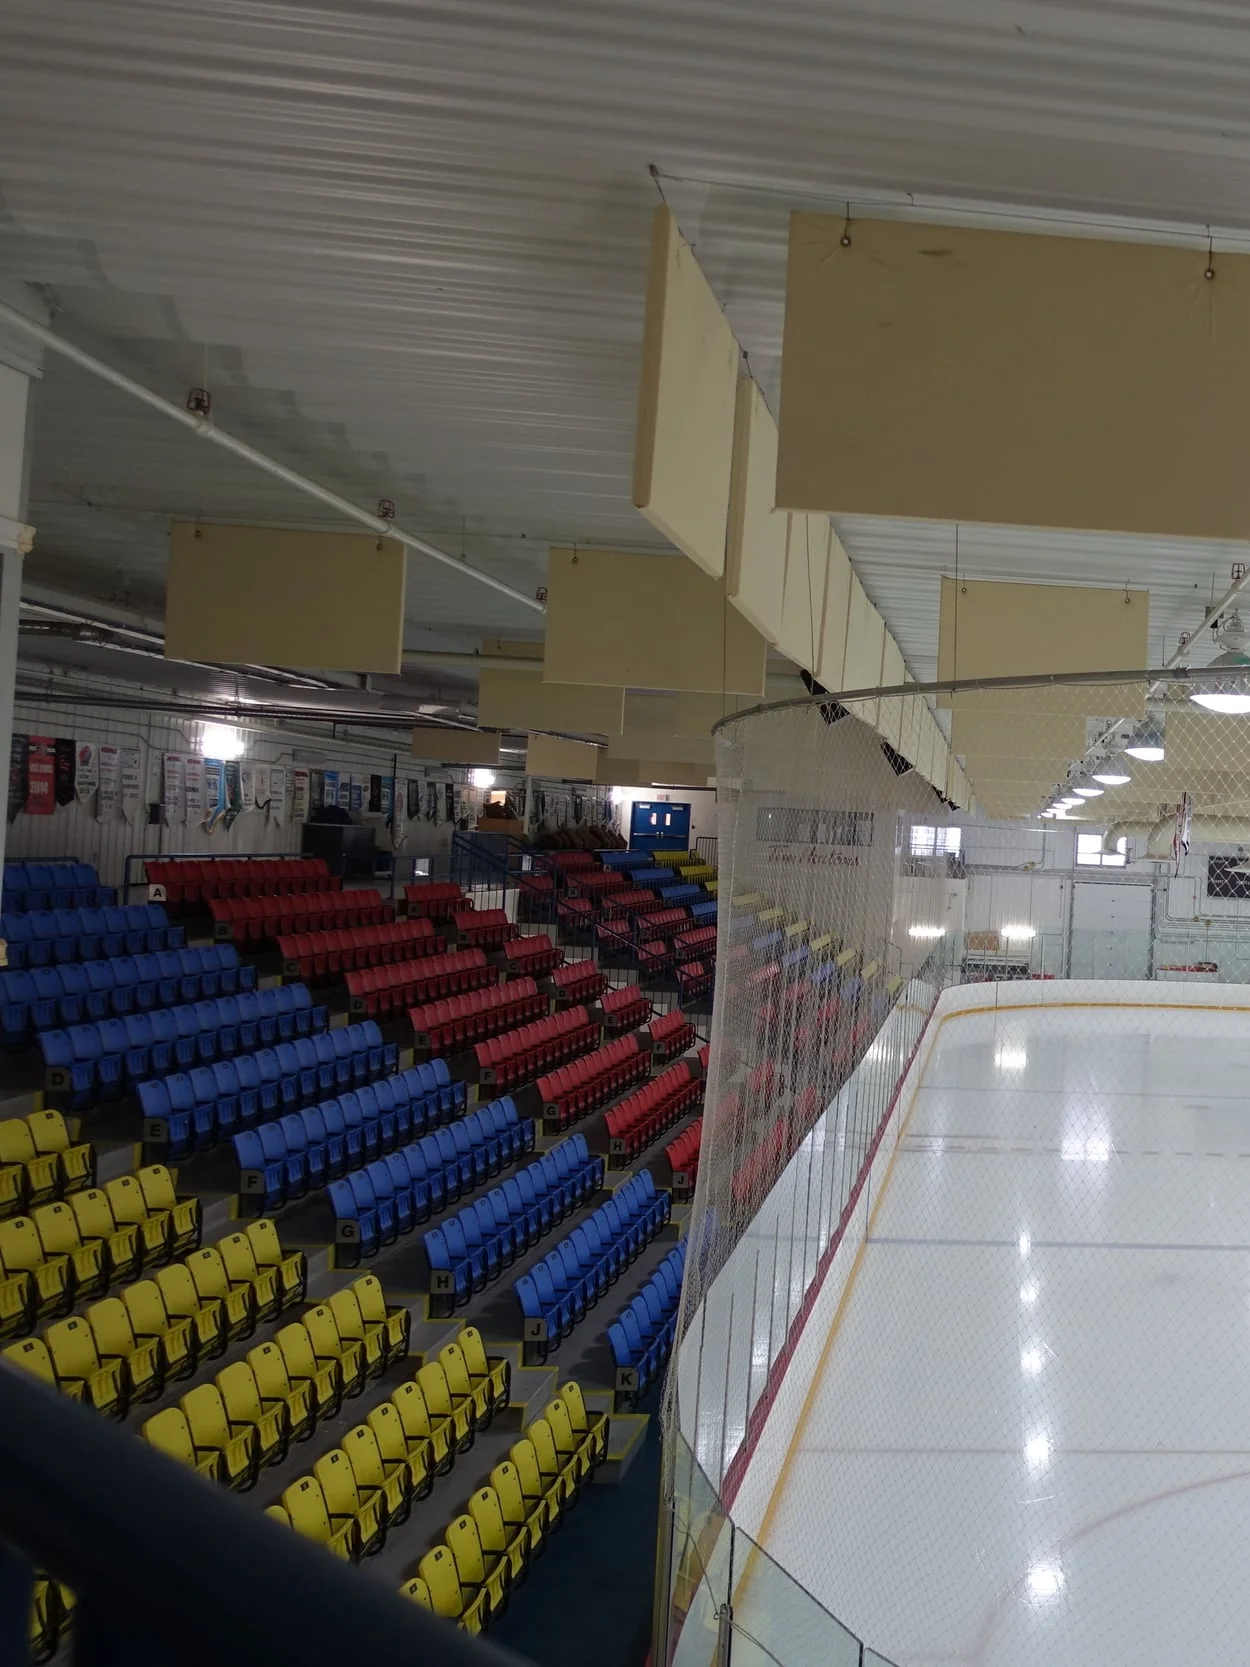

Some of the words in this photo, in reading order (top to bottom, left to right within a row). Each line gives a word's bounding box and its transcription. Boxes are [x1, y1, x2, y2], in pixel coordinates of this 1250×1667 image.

[30, 781, 49, 794] 2014
[154, 888, 162, 897] A
[219, 926, 227, 935] B
[287, 963, 295, 972] C
[419, 1036, 426, 1045] E
[656, 1043, 662, 1051] F
[52, 1073, 64, 1085] D
[485, 1072, 492, 1081] F
[547, 1106, 556, 1115] G
[150, 1124, 161, 1137] E
[613, 1142, 622, 1151] H
[247, 1176, 257, 1188] F
[677, 1176, 684, 1185] J
[342, 1225, 354, 1237] G
[437, 1276, 449, 1288] H
[531, 1324, 540, 1335] J
[621, 1373, 632, 1385] K
